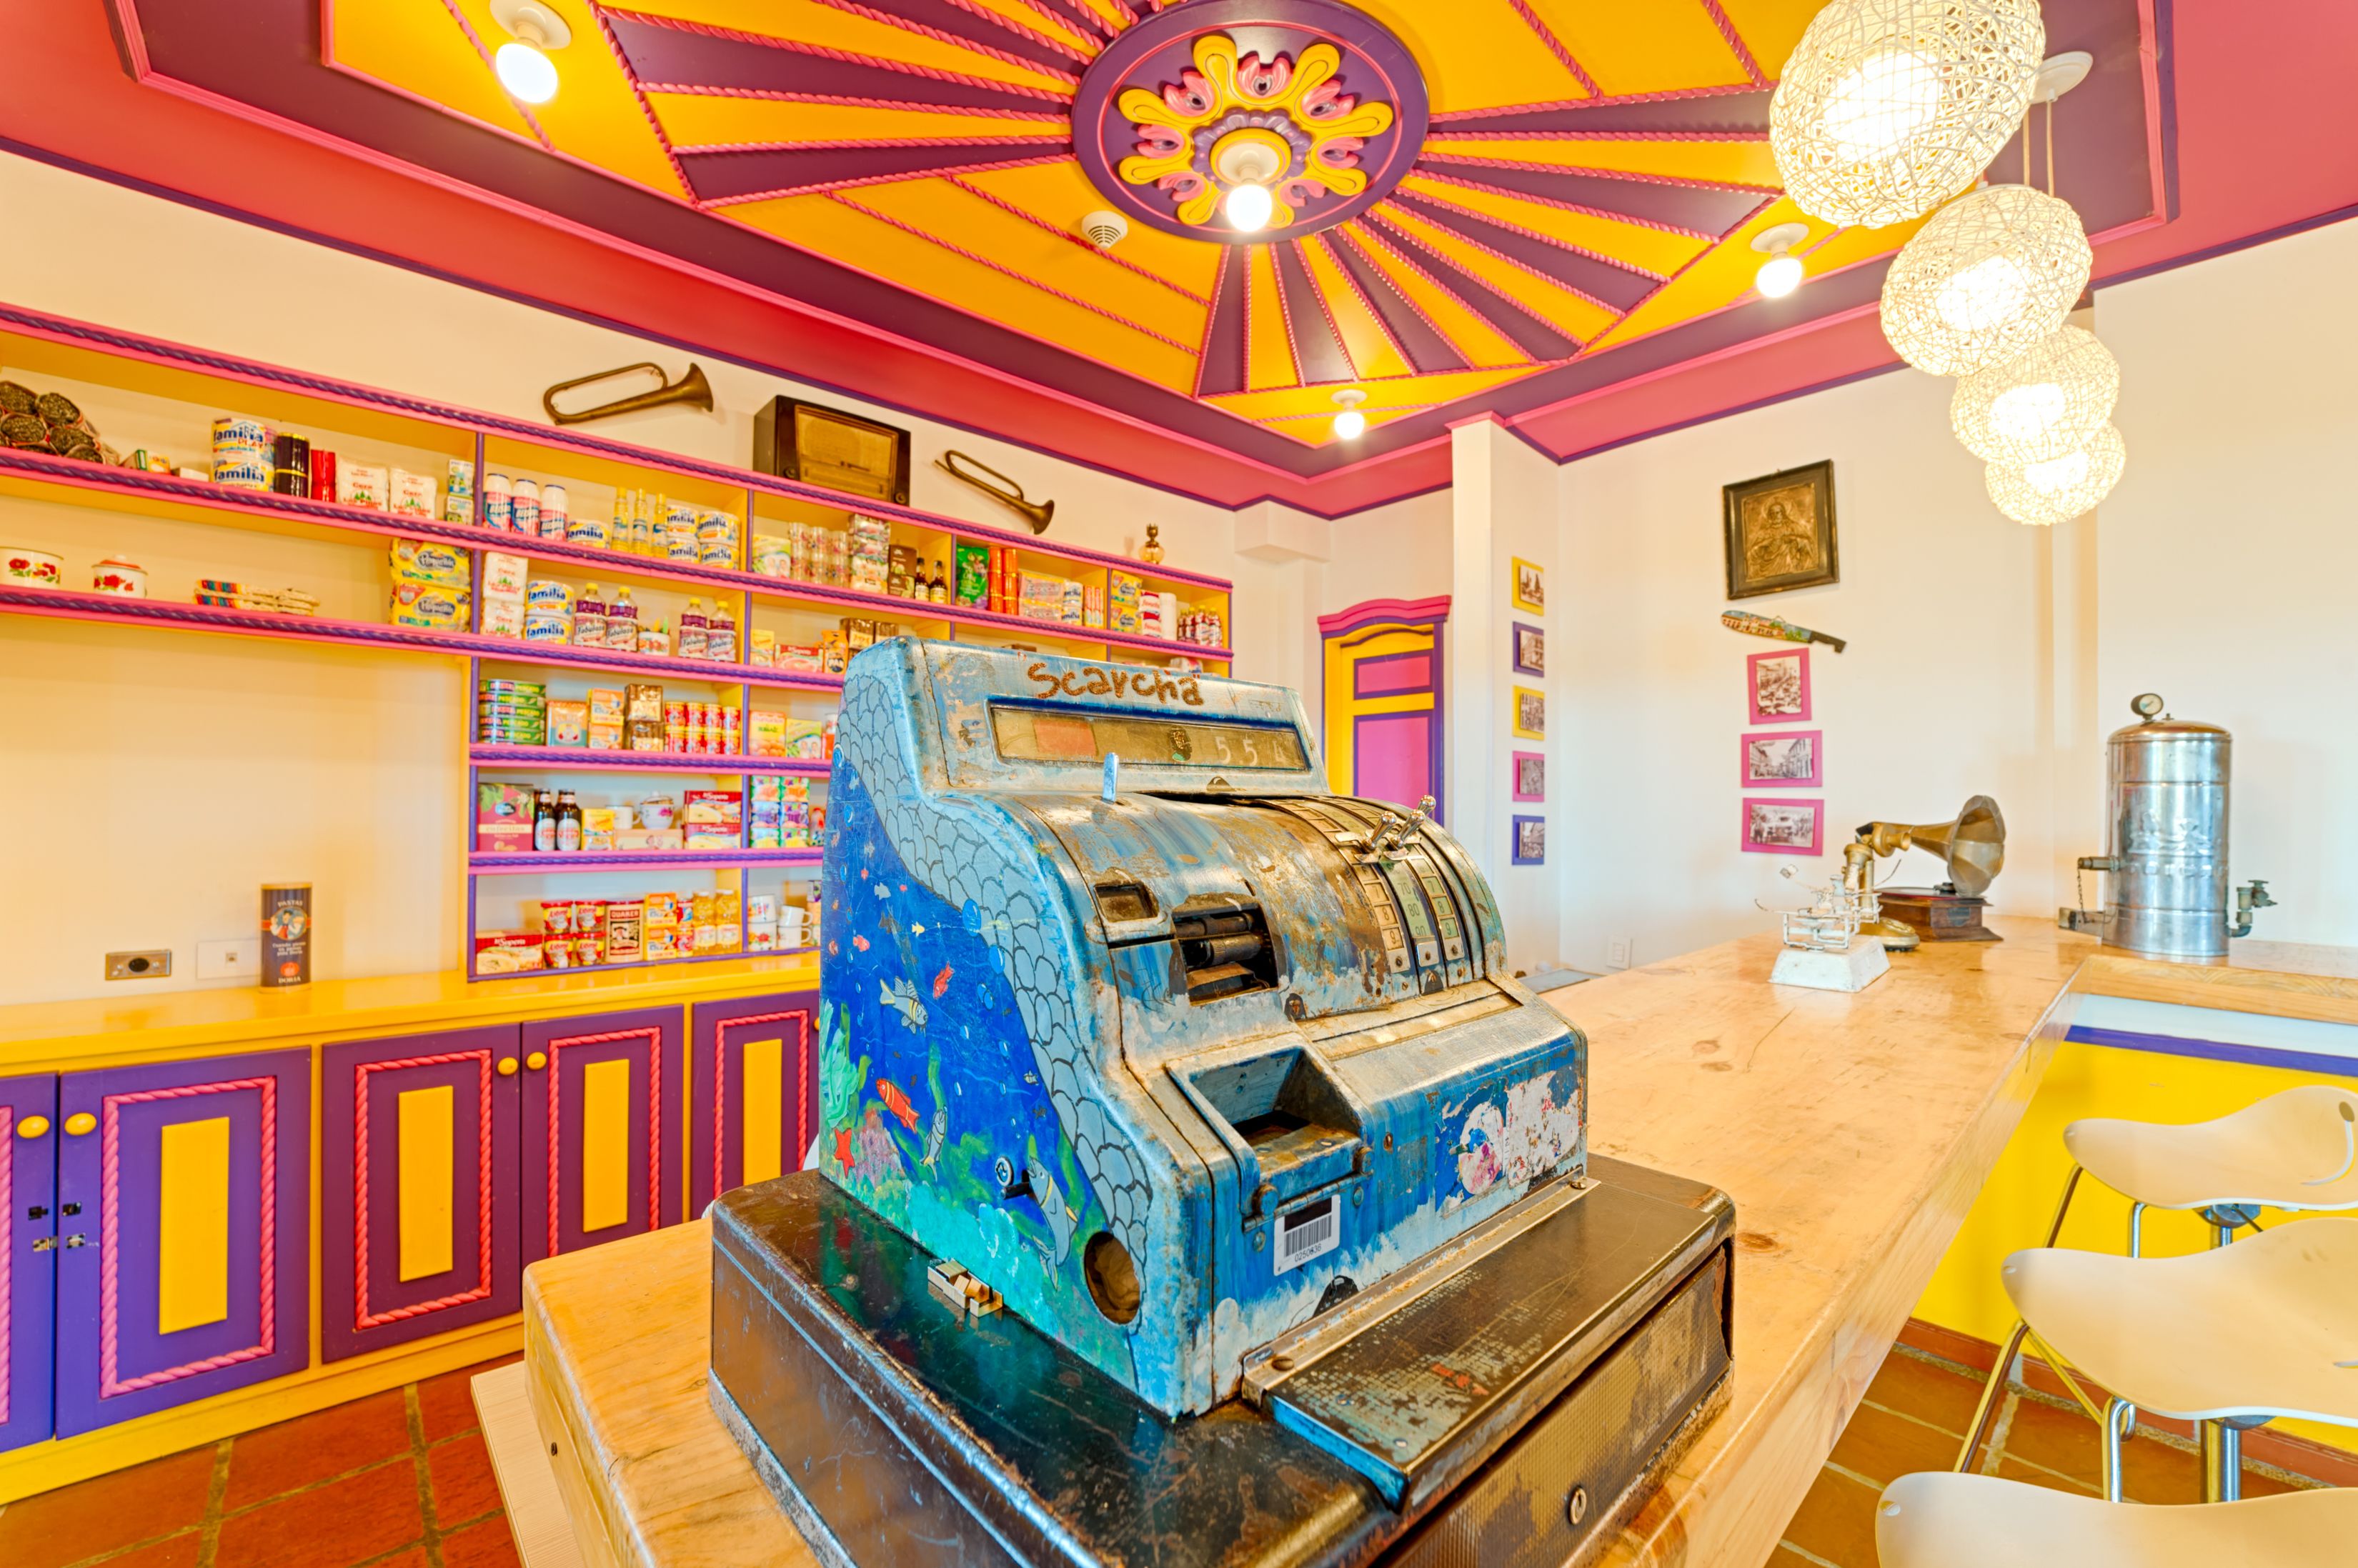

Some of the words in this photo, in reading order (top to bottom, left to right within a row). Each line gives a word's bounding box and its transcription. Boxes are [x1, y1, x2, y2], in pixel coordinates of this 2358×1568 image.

[1397, 882, 1411, 895] 70
[1382, 907, 1390, 921] 8
[1408, 903, 1420, 917] 80
[1437, 901, 1445, 914] 8
[1445, 922, 1453, 936] 9
[1390, 930, 1398, 944] 9
